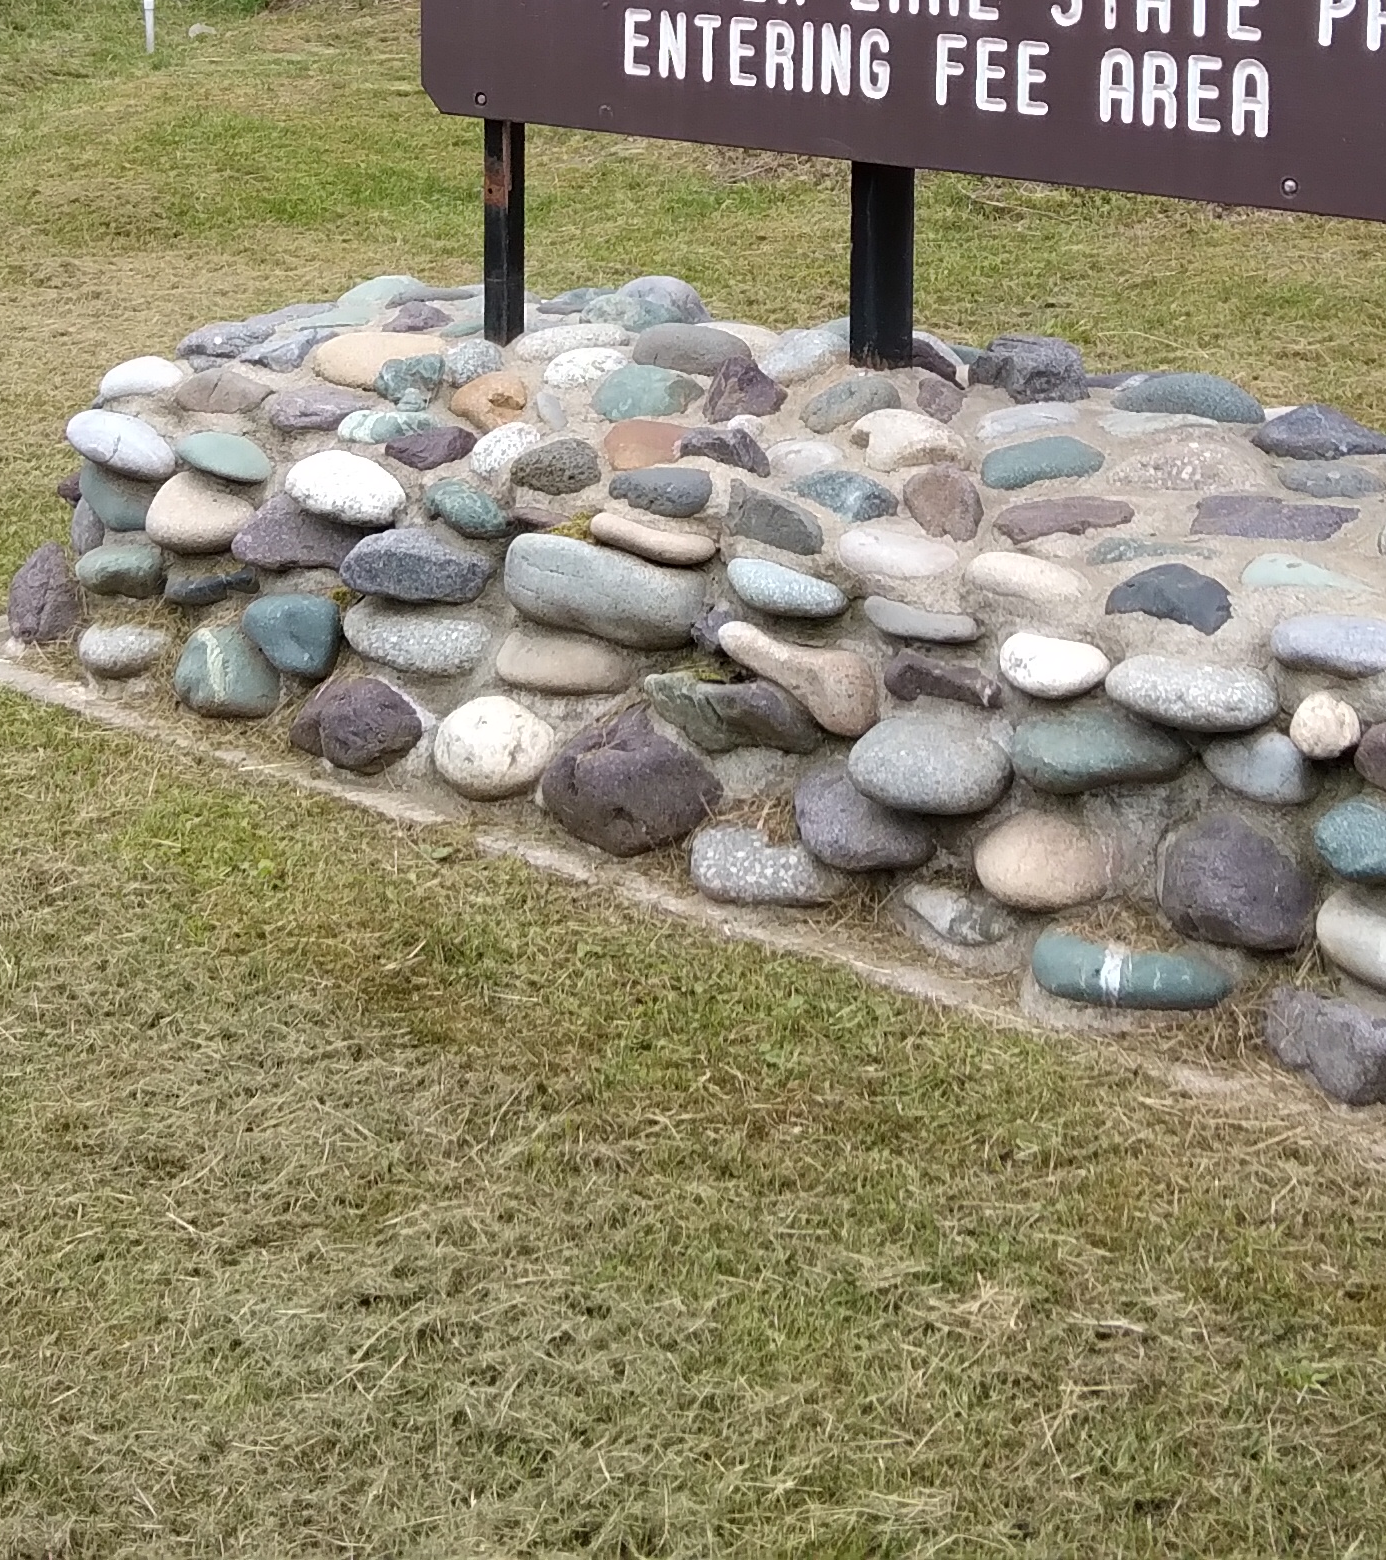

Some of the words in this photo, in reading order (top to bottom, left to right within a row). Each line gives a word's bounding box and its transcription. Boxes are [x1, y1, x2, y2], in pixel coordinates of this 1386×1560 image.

[623, 7, 891, 100] ENTERING
[935, 33, 1050, 116] FEE
[1099, 47, 1270, 138] AREA
